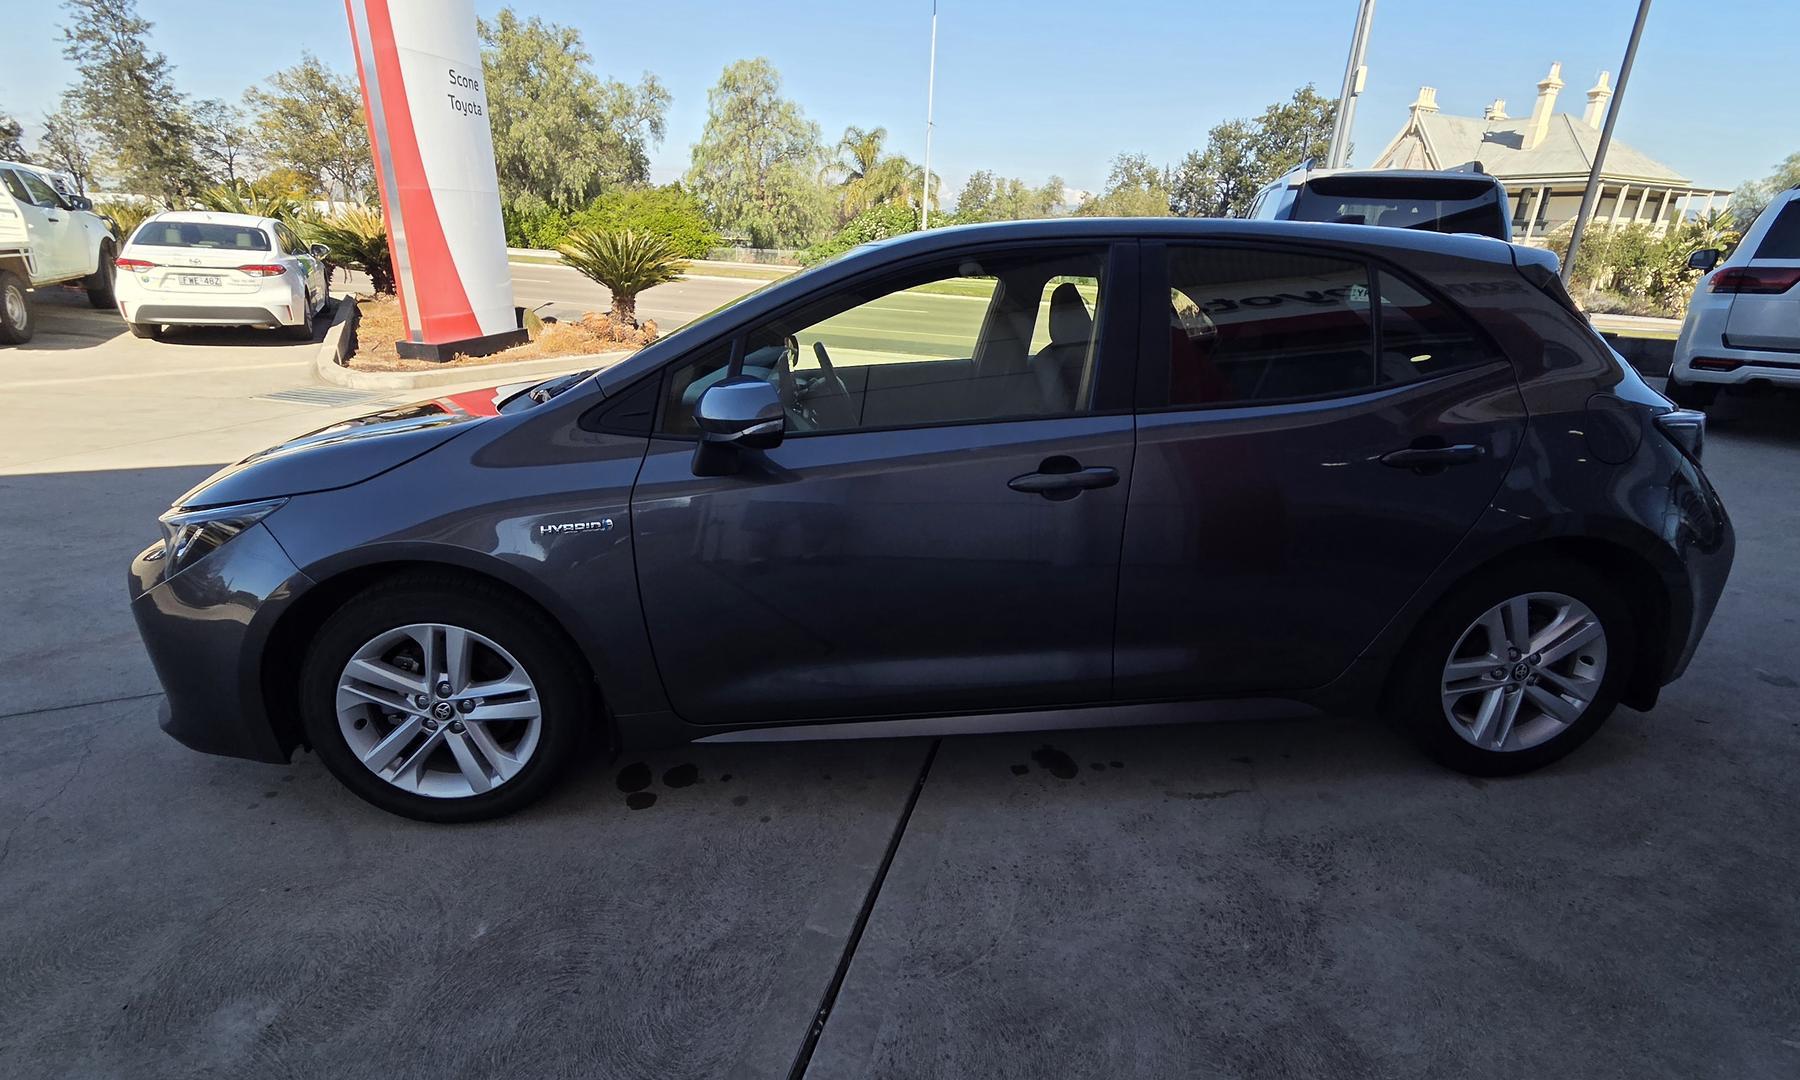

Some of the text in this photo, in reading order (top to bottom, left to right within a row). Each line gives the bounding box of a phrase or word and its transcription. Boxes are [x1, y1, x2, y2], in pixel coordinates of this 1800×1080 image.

[448, 69, 479, 91] Scone
[448, 94, 482, 116] Toyota
[540, 521, 602, 535] HYBRID
